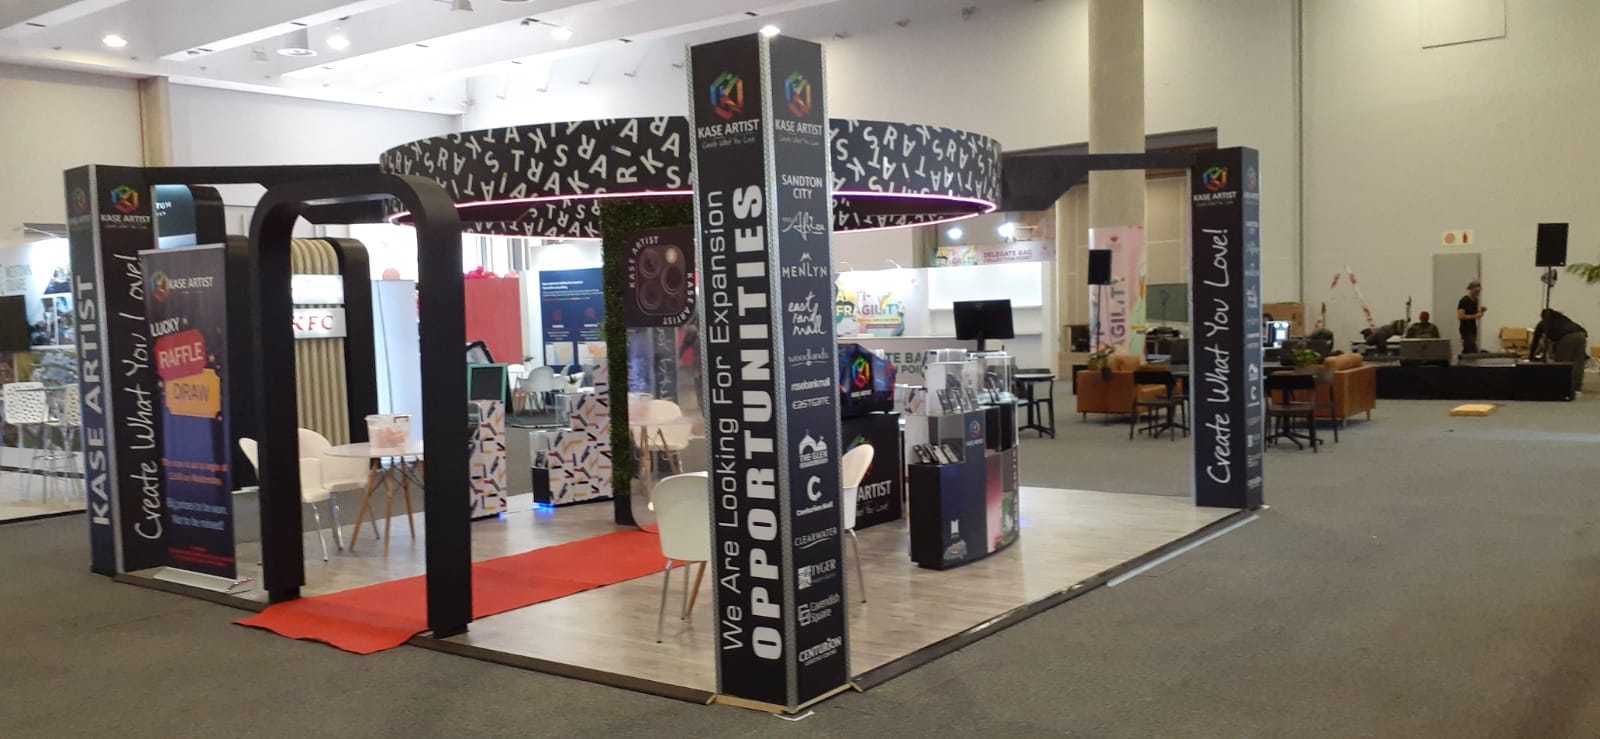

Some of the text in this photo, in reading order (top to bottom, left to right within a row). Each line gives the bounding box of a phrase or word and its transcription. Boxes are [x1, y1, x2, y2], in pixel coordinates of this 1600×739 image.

[698, 119, 760, 139] KASE ARTIST
[775, 119, 823, 136] KASE ARTIST
[781, 174, 823, 188] SANDTON
[793, 188, 813, 199] CITY
[1212, 191, 1237, 199] ARTIST
[123, 215, 151, 223] ARTIST
[628, 236, 659, 288] KASE ARTIST
[1202, 229, 1229, 287] Love!
[781, 262, 828, 278] MENLYN
[189, 276, 214, 289] ARTIST
[663, 306, 691, 326] ARTIST
[1203, 298, 1230, 337] You
[150, 317, 179, 337] LUCKY
[158, 342, 203, 369] RAFFLE
[788, 347, 829, 362] woodlands
[1204, 344, 1230, 402] What
[77, 275, 110, 525] KASE ARTIST
[173, 383, 209, 401] DRAW
[124, 384, 156, 450] What
[704, 190, 744, 650] We Are Looking For Expansion
[732, 184, 782, 660] OPPORTUNITIES
[1205, 413, 1231, 484] Create
[130, 460, 163, 540] Create
[857, 480, 892, 501] ARTIST
[794, 526, 837, 546] CLEARWATER
[812, 559, 836, 576] TYGER
